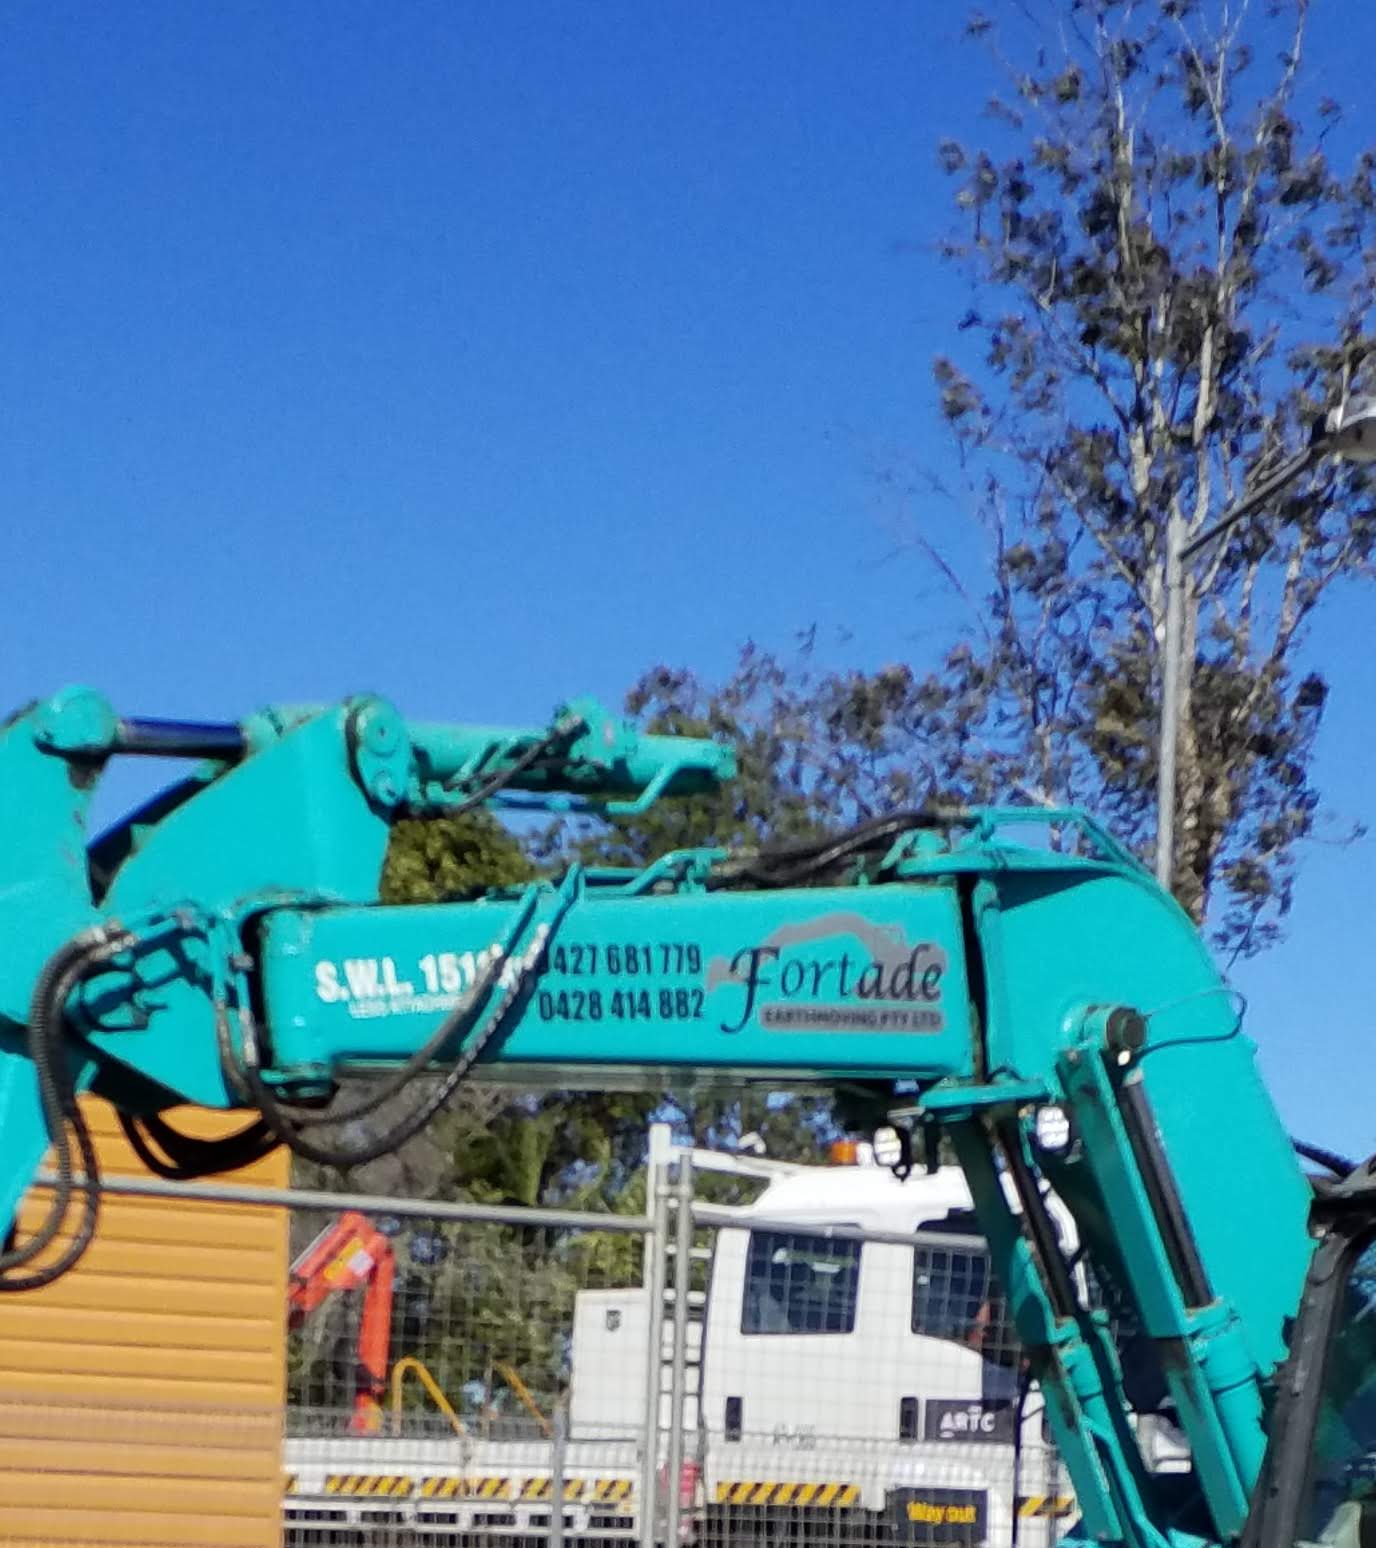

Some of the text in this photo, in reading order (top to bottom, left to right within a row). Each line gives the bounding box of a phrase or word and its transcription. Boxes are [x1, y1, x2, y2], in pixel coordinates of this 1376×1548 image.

[541, 942, 701, 975] 427 681 779
[539, 986, 704, 1020] 0428 414 882
[720, 943, 943, 1033] Fortade
[939, 1409, 995, 1433] ARTC
